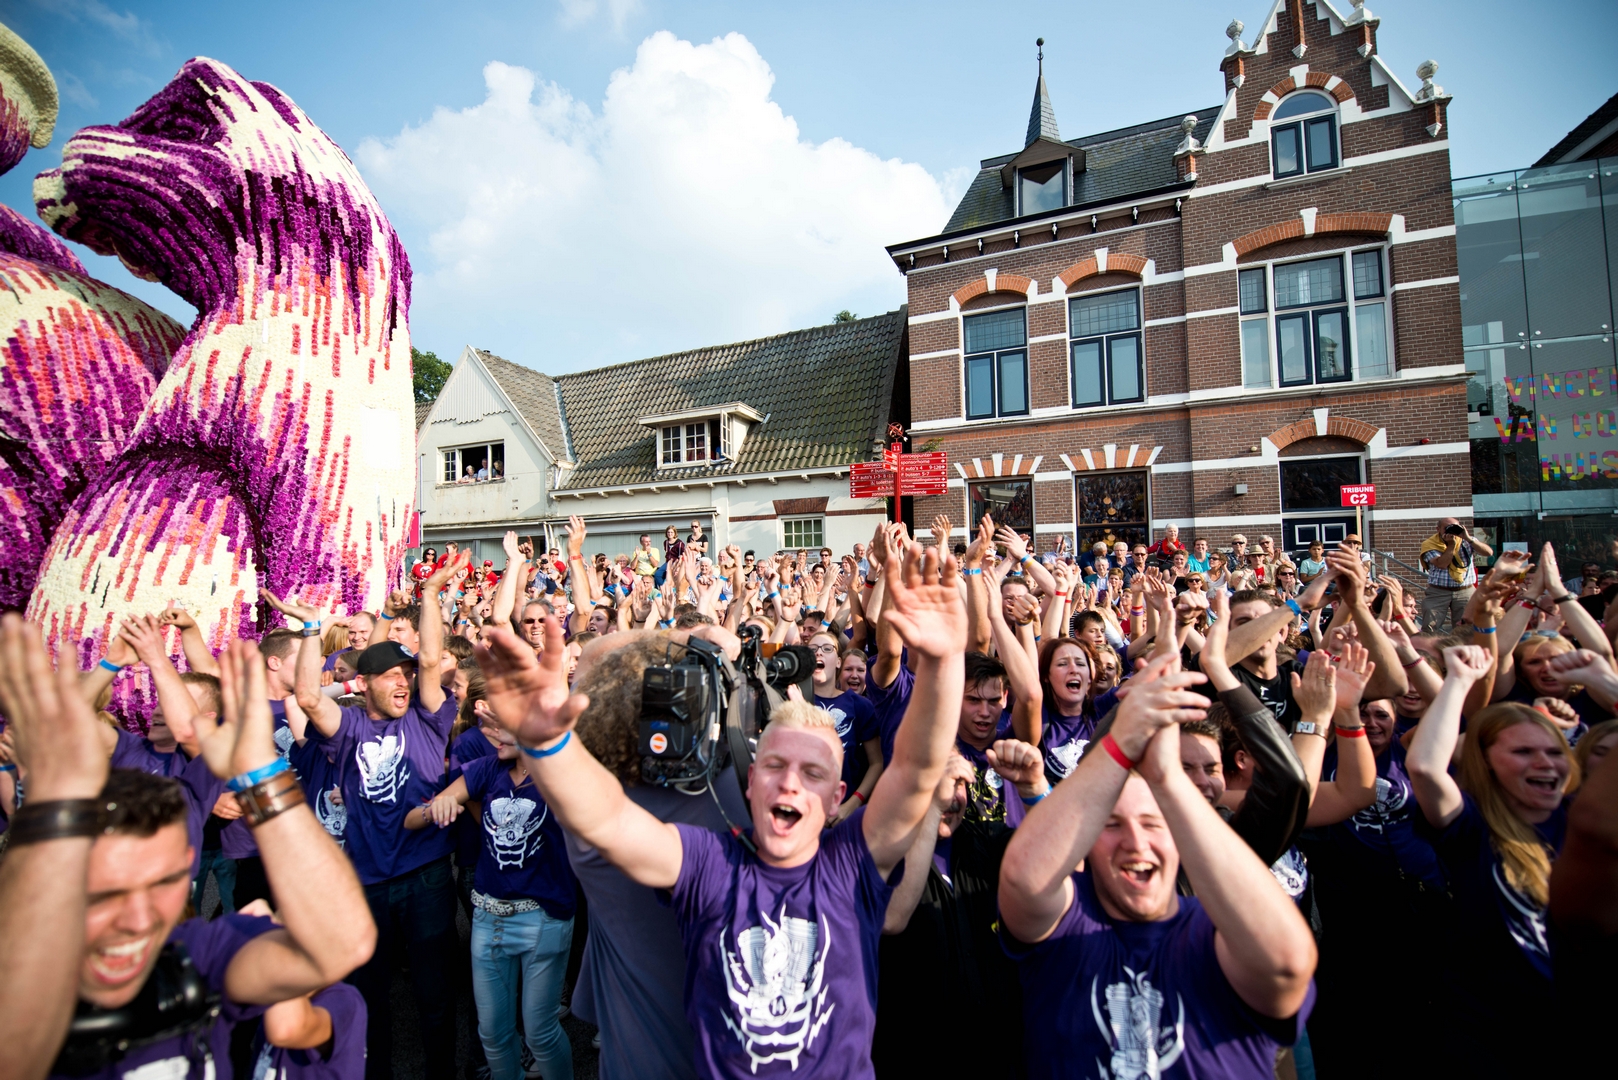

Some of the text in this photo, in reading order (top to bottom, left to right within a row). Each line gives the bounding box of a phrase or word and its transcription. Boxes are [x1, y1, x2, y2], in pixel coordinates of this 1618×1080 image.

[1493, 413, 1557, 443] VAN
[1541, 450, 1618, 482] HUIS
[1350, 494, 1368, 504] C2
